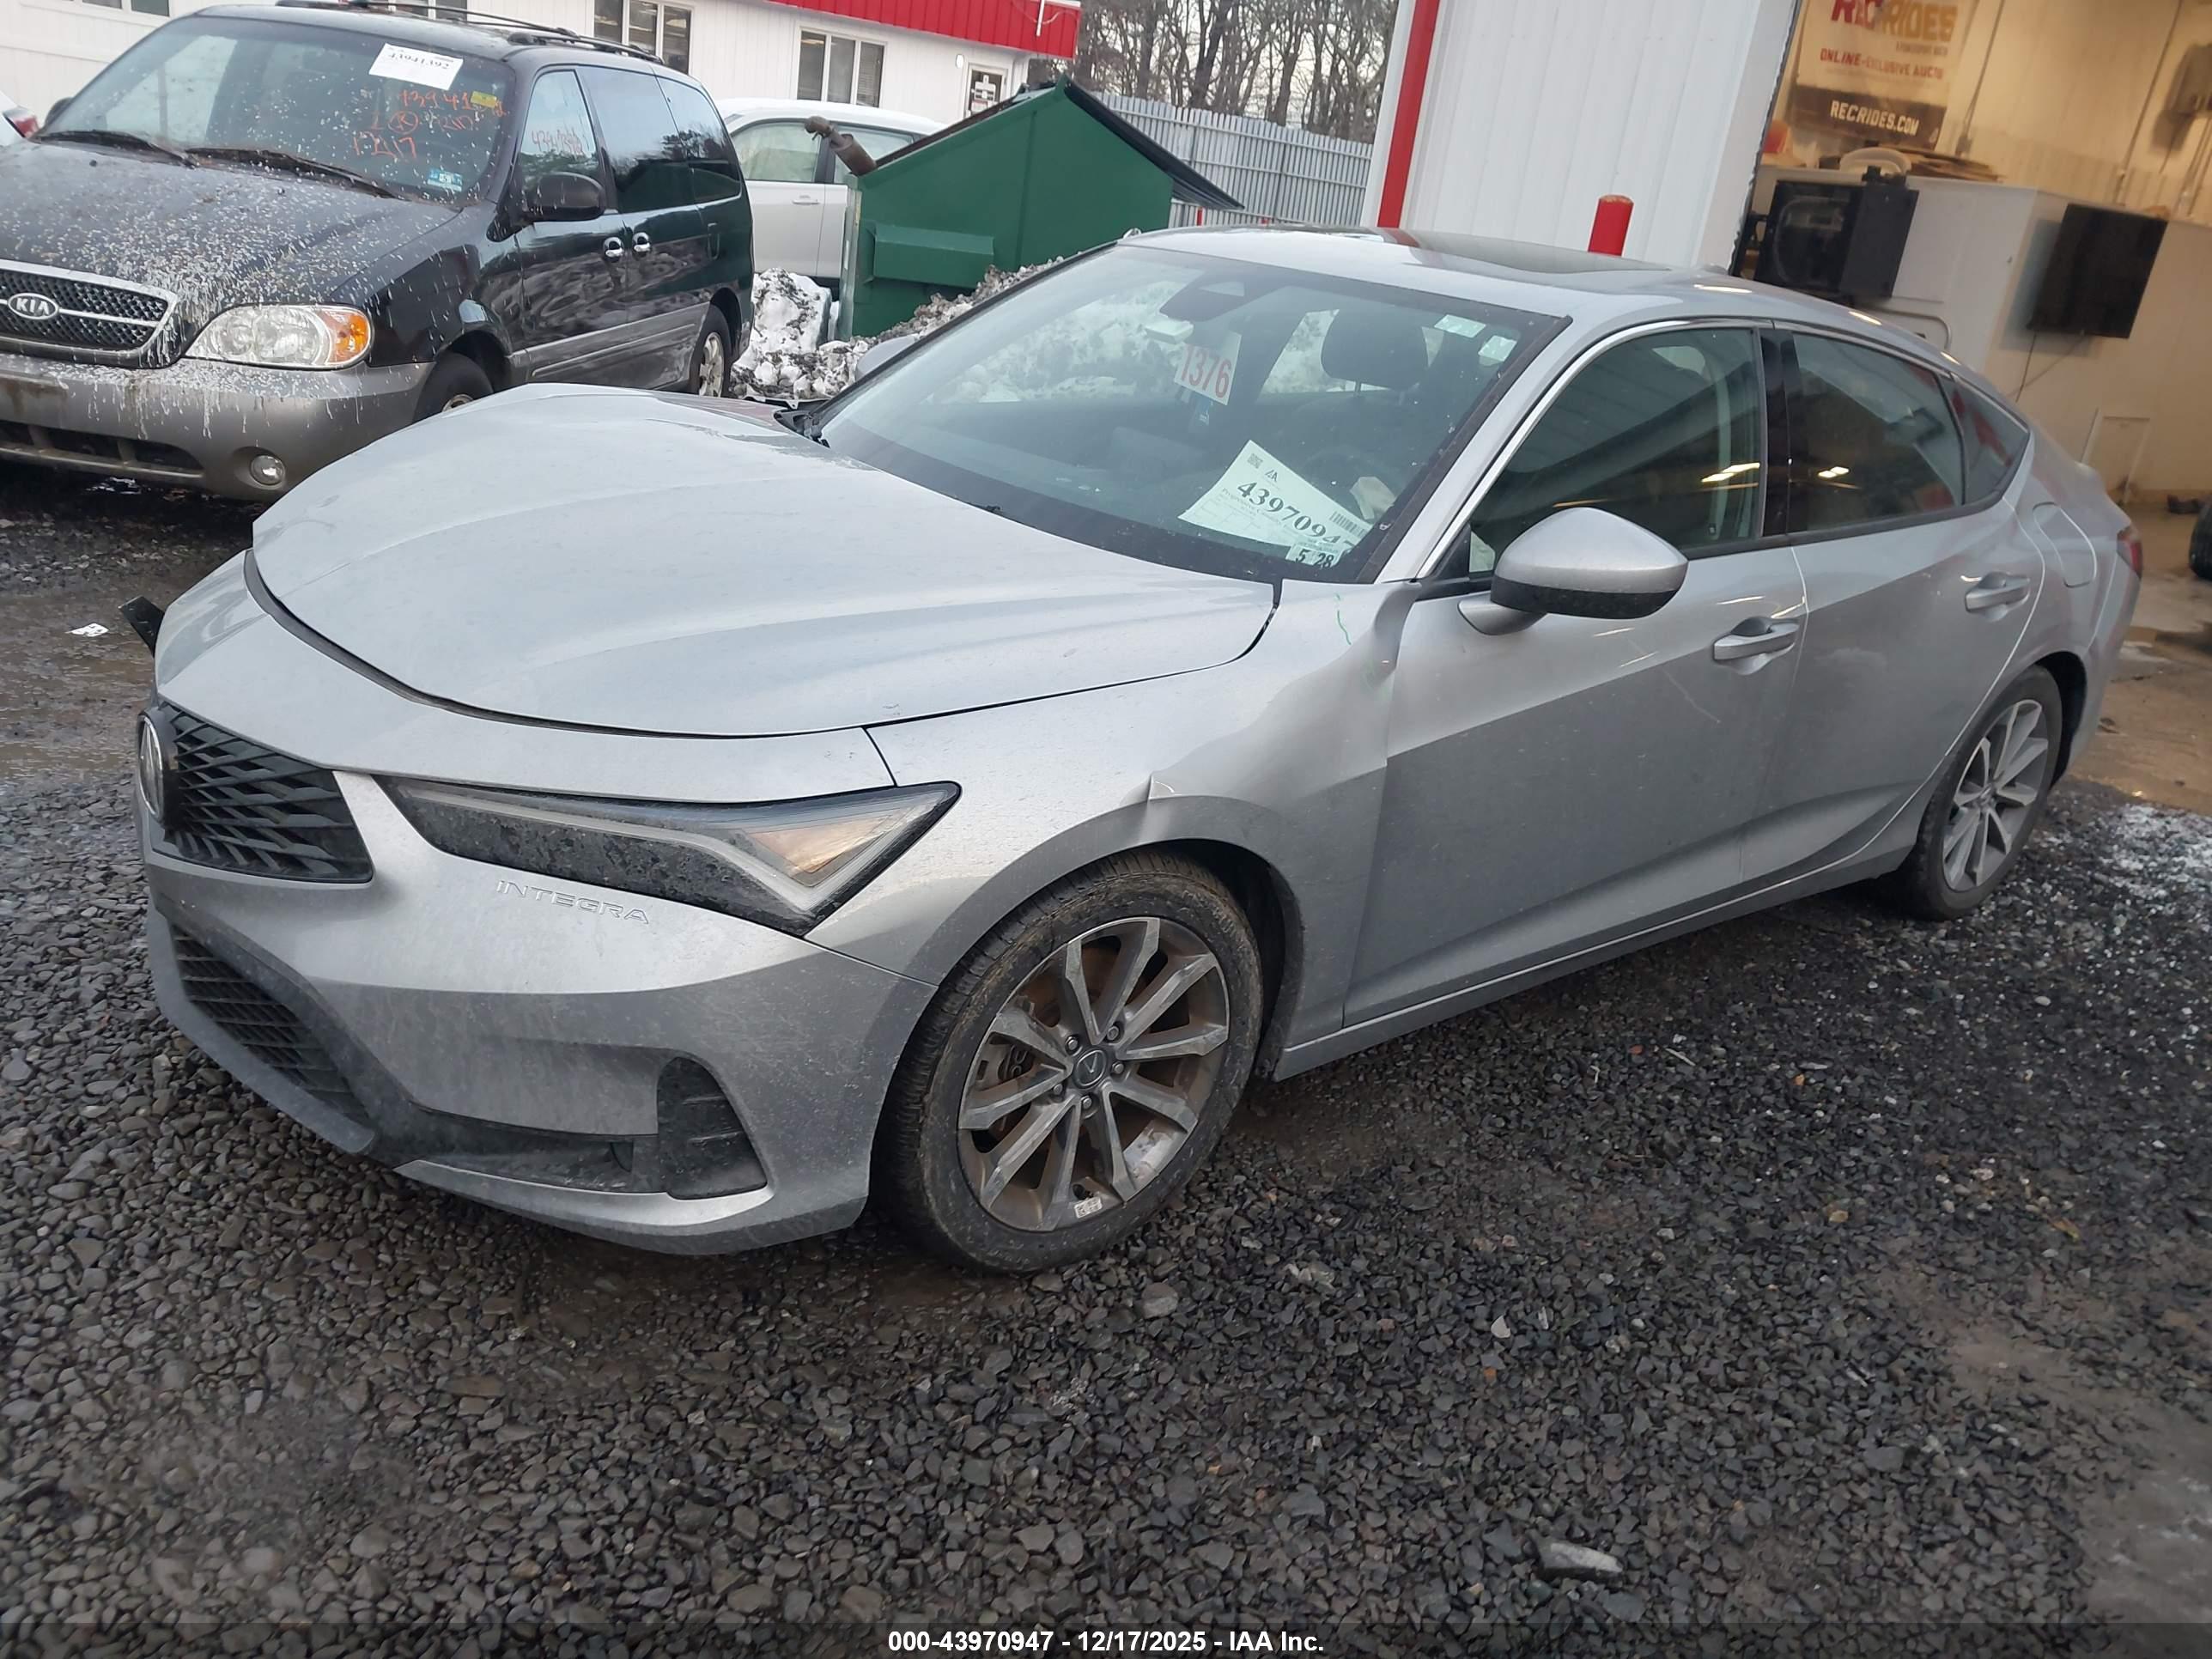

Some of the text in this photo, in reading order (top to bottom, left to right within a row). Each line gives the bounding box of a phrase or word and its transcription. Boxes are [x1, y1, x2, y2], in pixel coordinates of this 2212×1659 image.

[1830, 100, 1920, 136] RECRIDES.COM
[16, 297, 49, 315] KIA
[1182, 344, 1232, 398] 1376
[496, 880, 649, 925] INTEGRA
